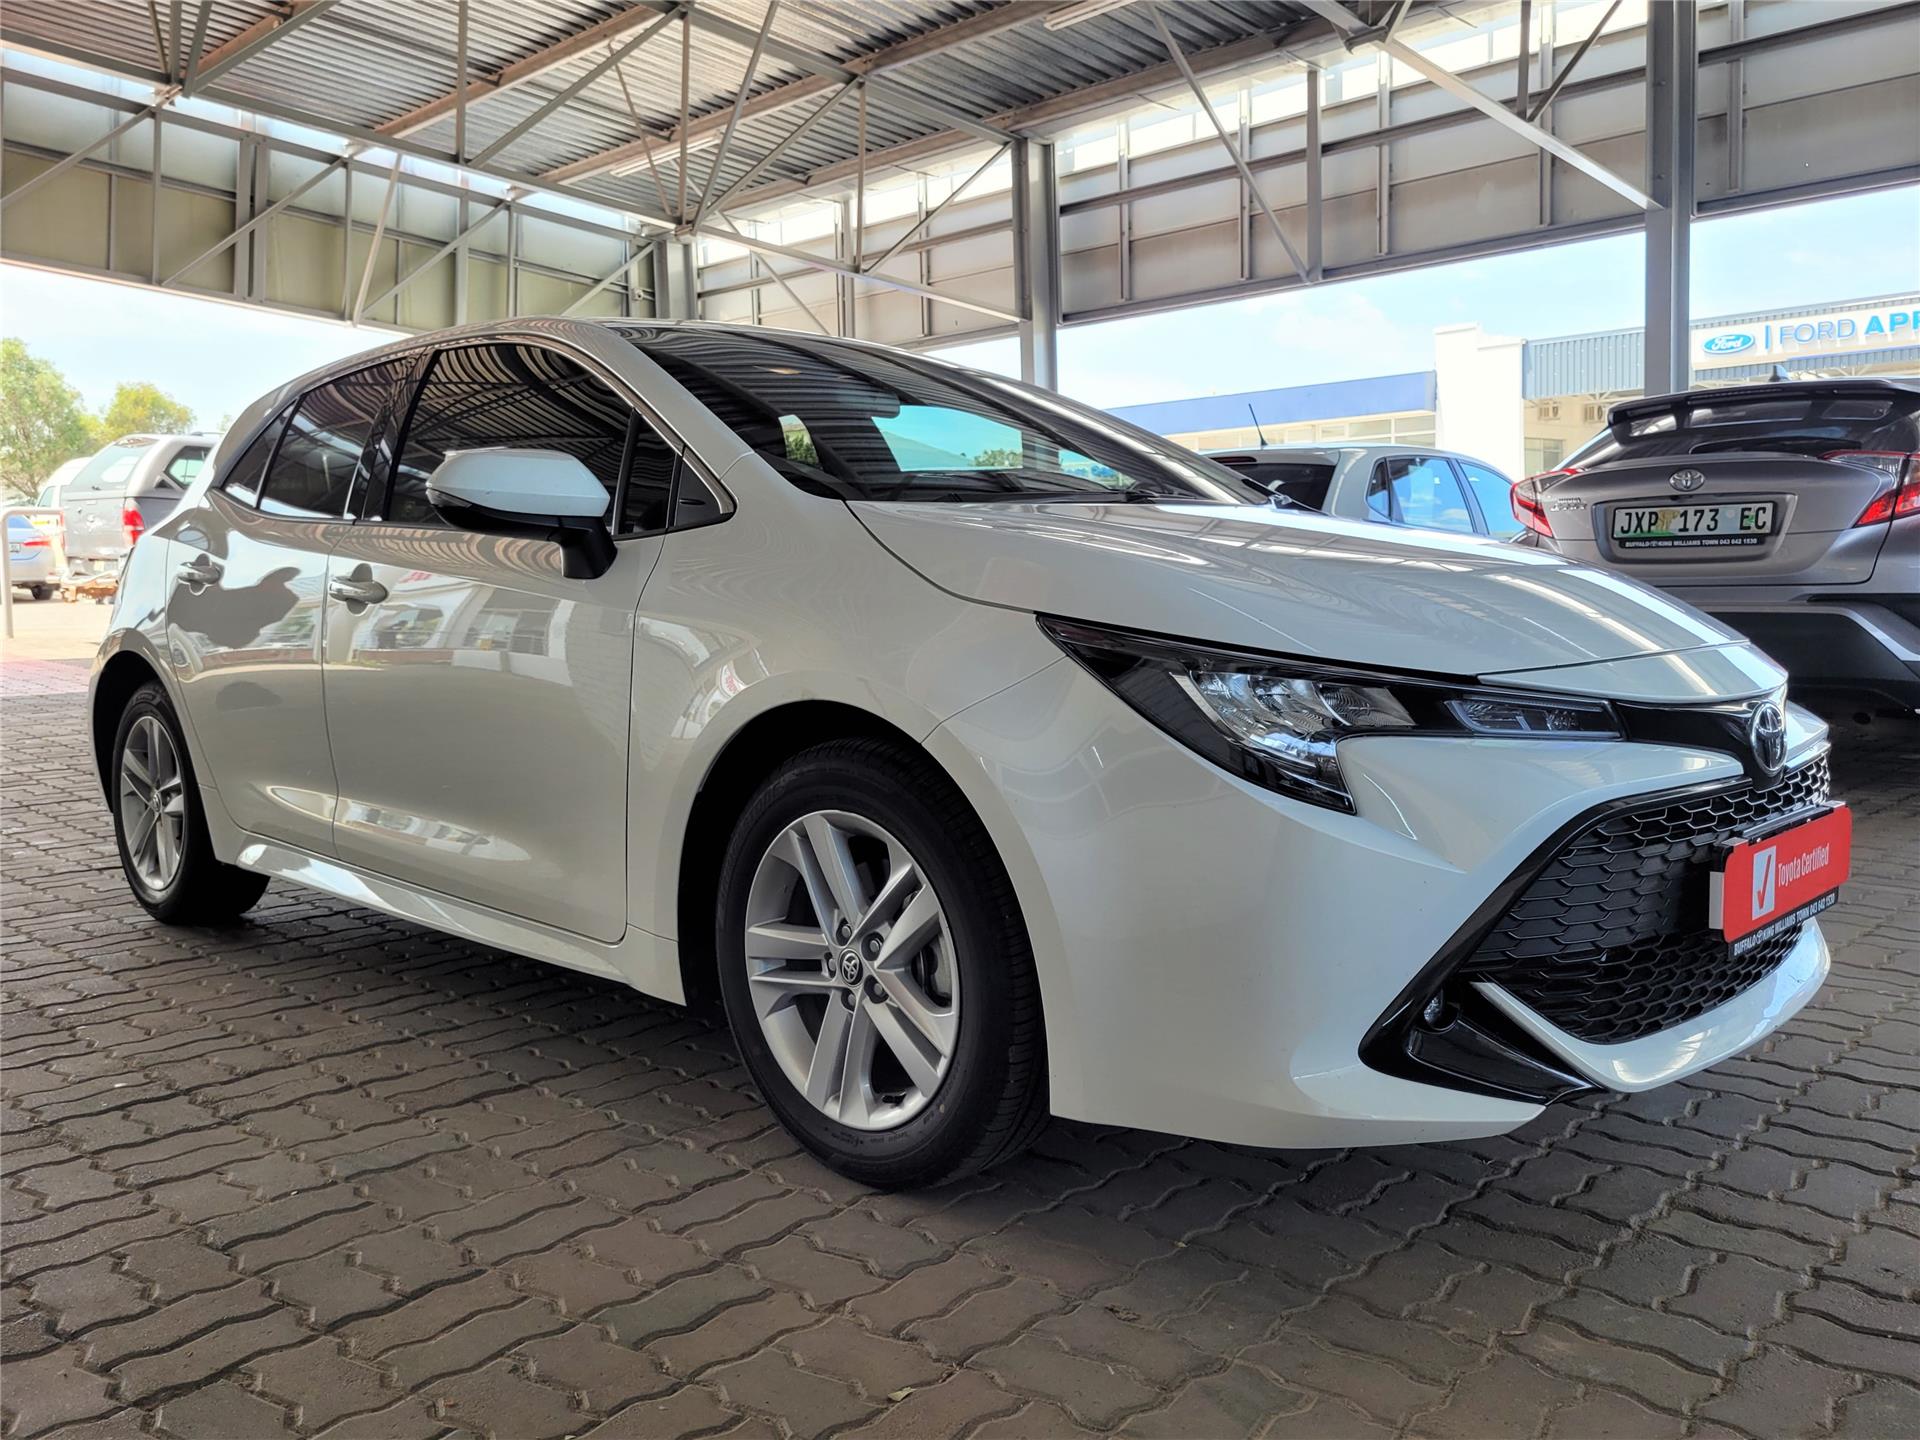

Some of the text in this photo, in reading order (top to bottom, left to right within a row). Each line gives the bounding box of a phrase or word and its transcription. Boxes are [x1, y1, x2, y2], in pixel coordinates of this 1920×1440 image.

[1711, 336, 1743, 351] Ford
[1779, 319, 1856, 344] FORD
[1620, 506, 1767, 534] JXP 173 EC
[1778, 843, 1829, 887] Toyota Certified
[1734, 935, 1756, 956] BUFFALO
[1763, 925, 1774, 940] KING
[1775, 914, 1796, 934] WILLIAMS
[1797, 905, 1809, 921] TOWN
